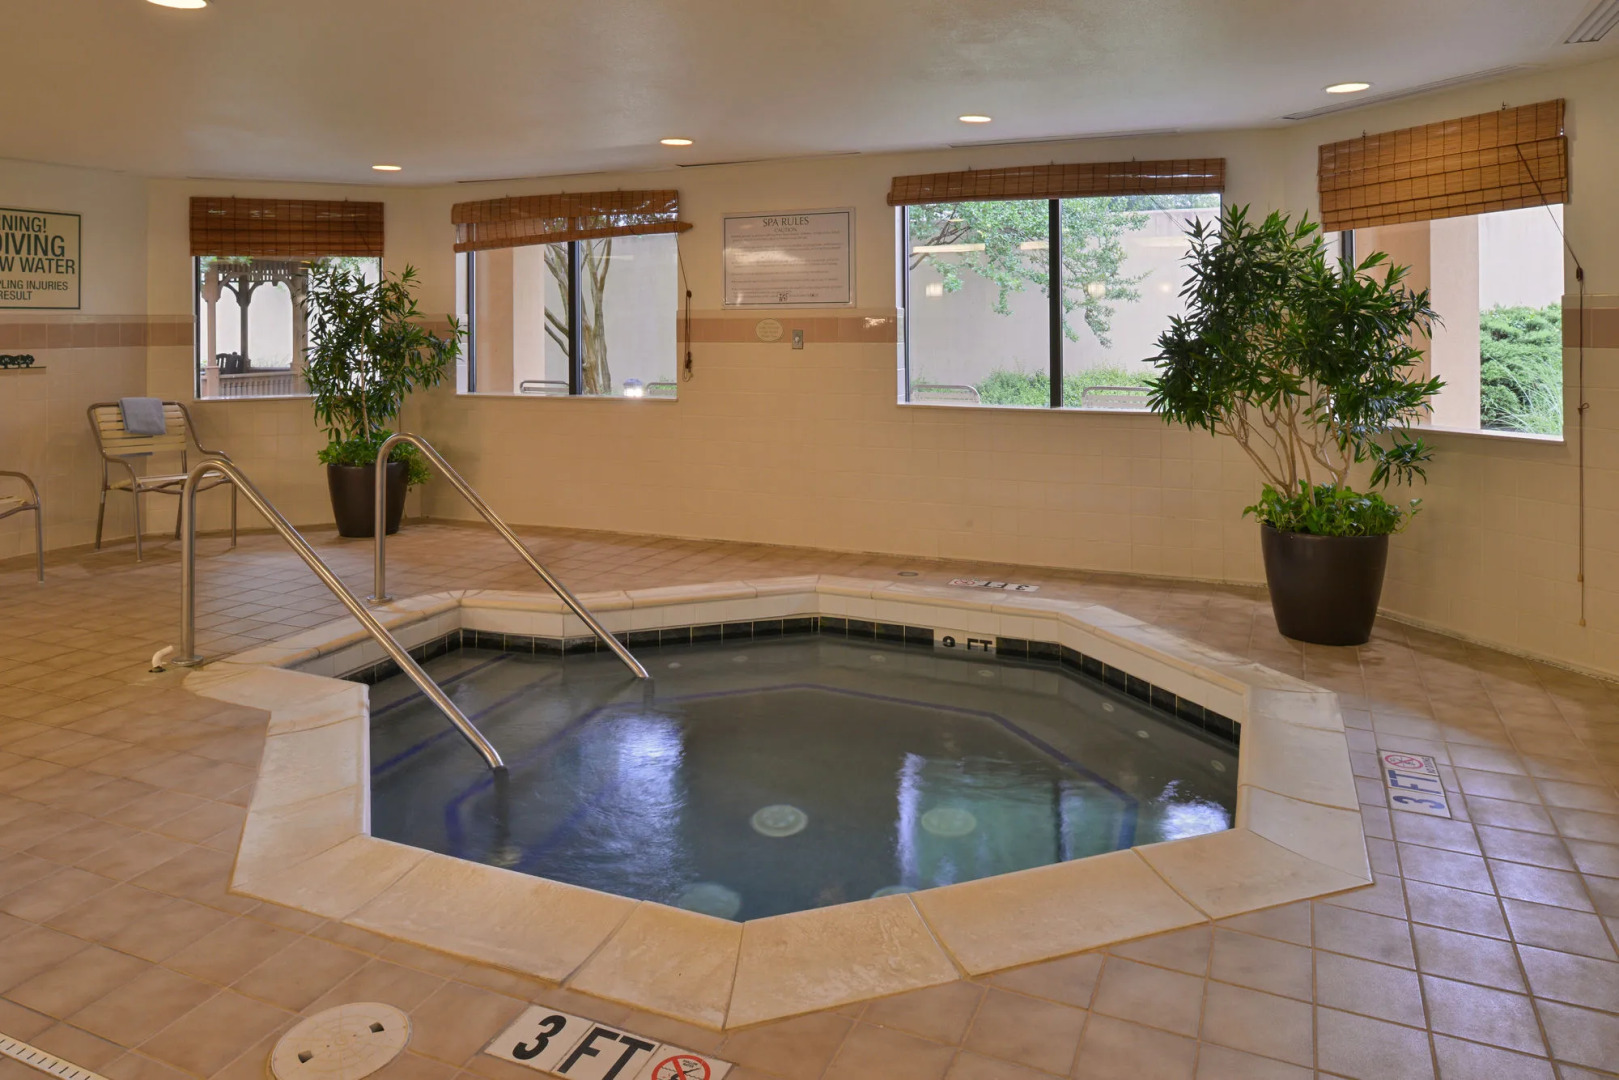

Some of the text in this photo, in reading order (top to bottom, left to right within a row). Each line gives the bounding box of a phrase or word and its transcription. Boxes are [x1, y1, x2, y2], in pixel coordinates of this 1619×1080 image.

[762, 216, 810, 227] SPA RULES
[0, 232, 66, 257] IVING
[19, 256, 76, 274] WATER
[0, 279, 69, 291] LING INJURIES
[977, 581, 1008, 589] FT
[1387, 769, 1446, 810] 3 FT
[512, 1015, 656, 1080] 3 FT
